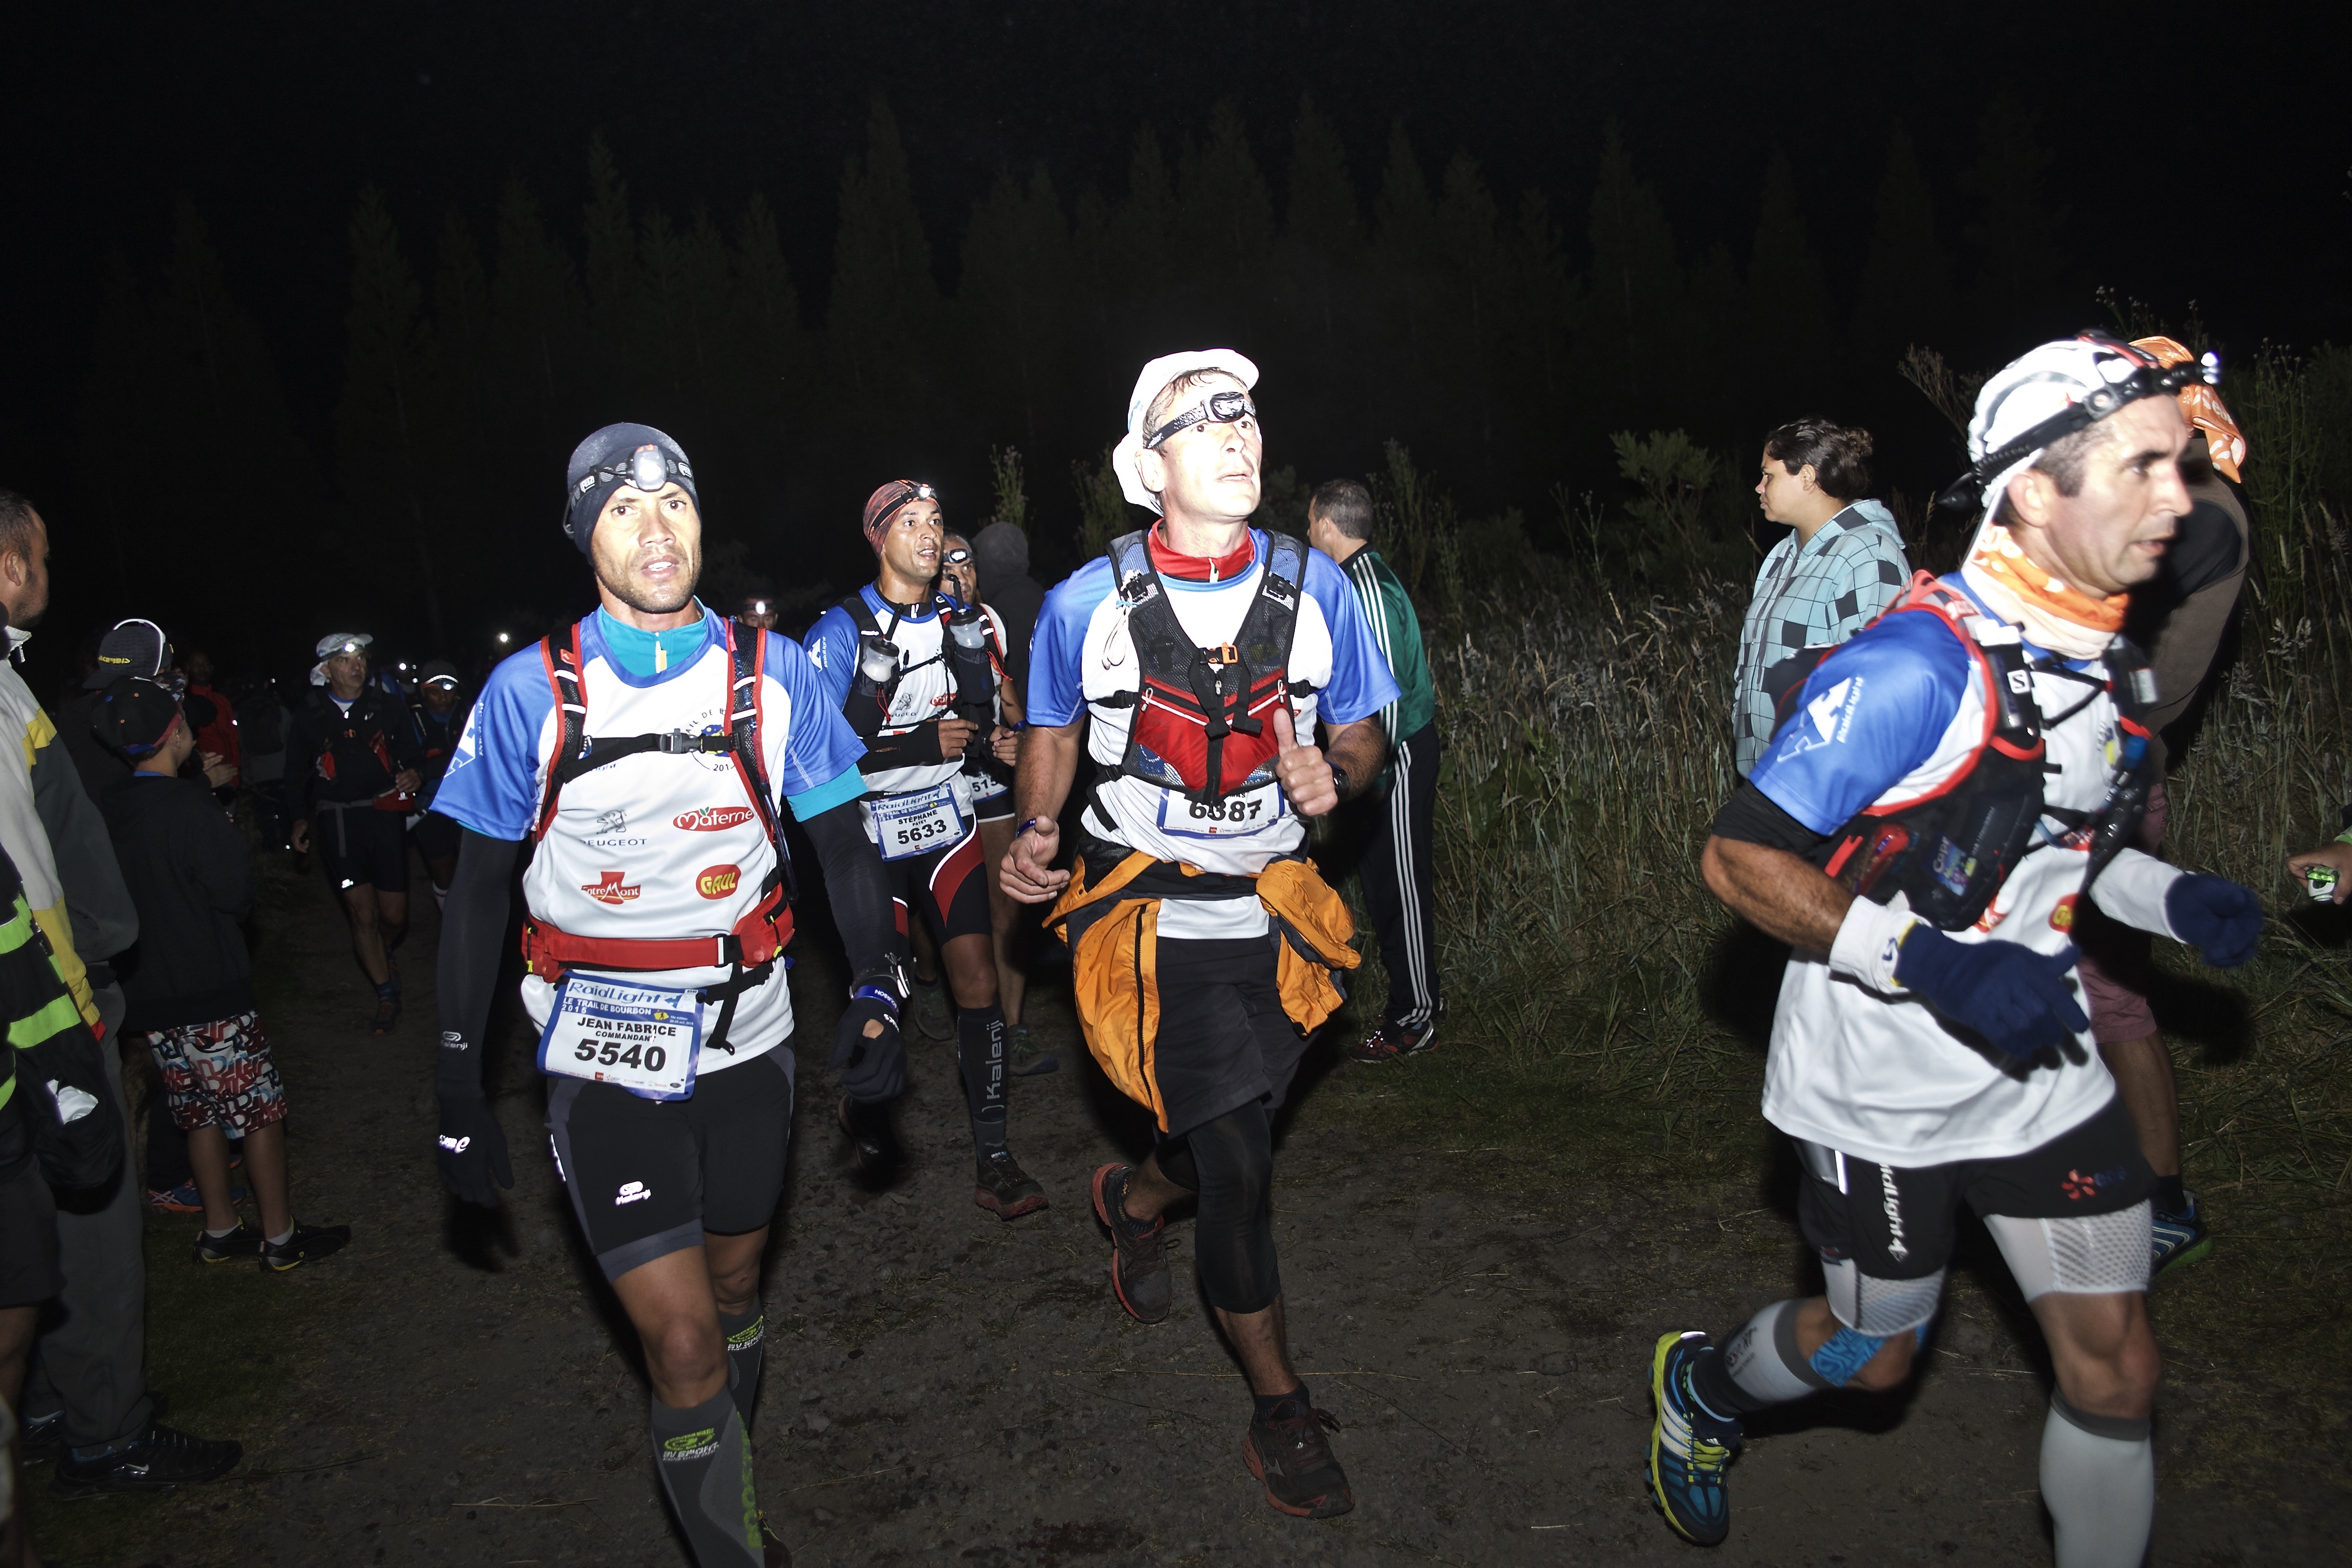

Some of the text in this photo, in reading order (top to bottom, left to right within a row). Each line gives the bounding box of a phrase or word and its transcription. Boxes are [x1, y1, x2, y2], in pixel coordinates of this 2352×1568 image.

[877, 794, 931, 810] RaidLight
[908, 803, 929, 812] BOURBON
[677, 809, 754, 830] Materne
[898, 809, 938, 825] STÉPHANE
[897, 819, 947, 845] 5633
[568, 982, 662, 1004] RaidLight
[561, 1004, 587, 1014] 2015
[578, 999, 598, 1009] TRAIL
[610, 1005, 652, 1015] BOURBON
[577, 1017, 676, 1037] JEAN FABRICE
[595, 1030, 657, 1042] COMMANDANT
[574, 1038, 666, 1072] 5540
